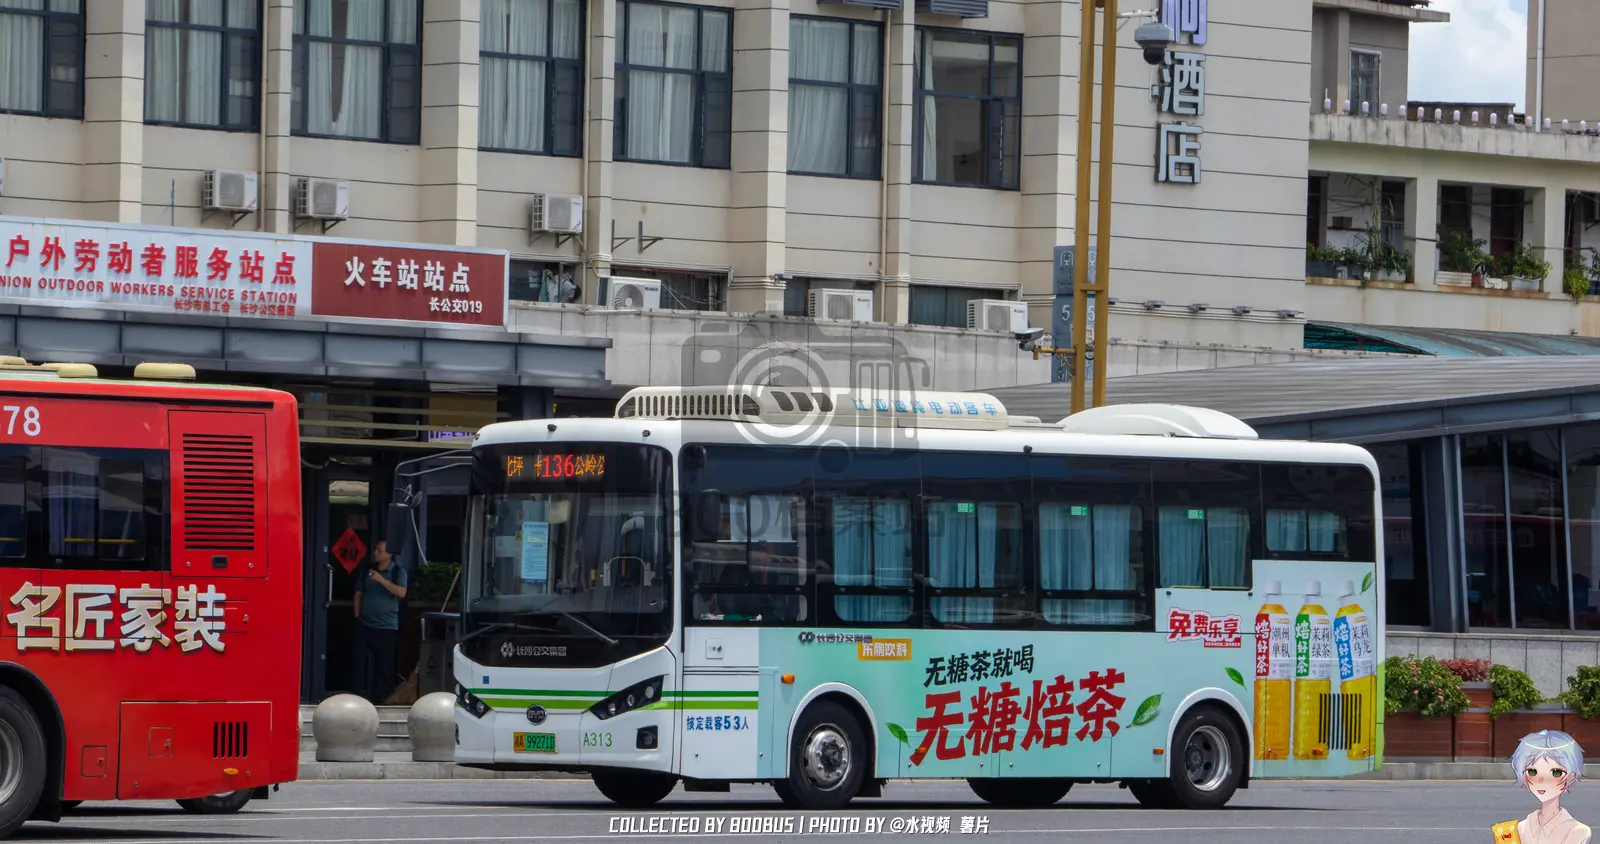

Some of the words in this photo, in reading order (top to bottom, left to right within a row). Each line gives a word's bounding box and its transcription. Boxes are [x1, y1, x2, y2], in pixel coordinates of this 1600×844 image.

[5, 234, 297, 285] 户外劳动者服务站点
[343, 256, 471, 293] 火车站站点
[38, 277, 104, 292] OUTDOOR
[111, 282, 175, 297] WORKERS
[181, 286, 235, 300] SERVICE
[241, 290, 297, 304] STATION
[429, 297, 483, 314] 长公交019
[0, 405, 41, 436] 78
[851, 397, 999, 417] 比亚迪纯电动客车
[541, 454, 575, 478] 136
[1168, 610, 1240, 640] 免费乐享
[1255, 619, 1271, 674] 焙好茶
[1295, 619, 1311, 674] 焙好茶
[1334, 622, 1352, 677] 焙好茶
[923, 644, 1034, 688] 无糖茶就喝
[686, 715, 749, 732] 核定载客53人
[909, 668, 1127, 767] 无糖焙茶
[583, 732, 613, 747] A313
